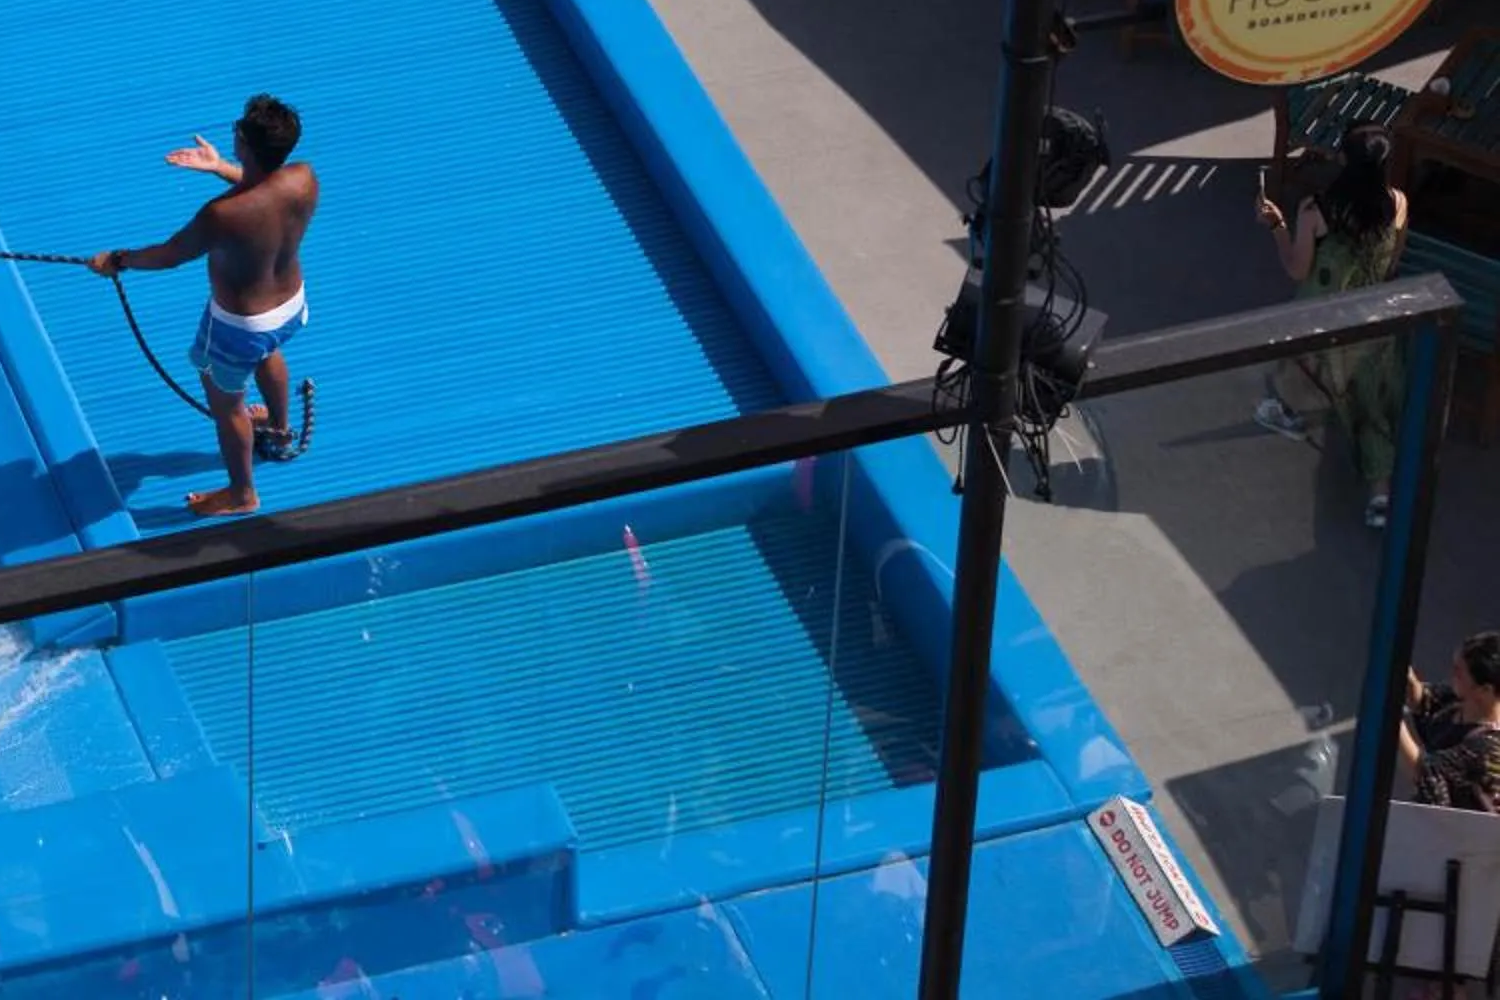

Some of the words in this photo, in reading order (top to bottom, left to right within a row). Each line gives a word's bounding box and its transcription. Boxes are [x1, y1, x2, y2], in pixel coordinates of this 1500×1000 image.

[1246, 2, 1373, 30] BOARDRIDERS
[1112, 828, 1132, 854] DO
[1125, 854, 1153, 886] NOT
[1146, 889, 1180, 931] JUMP
